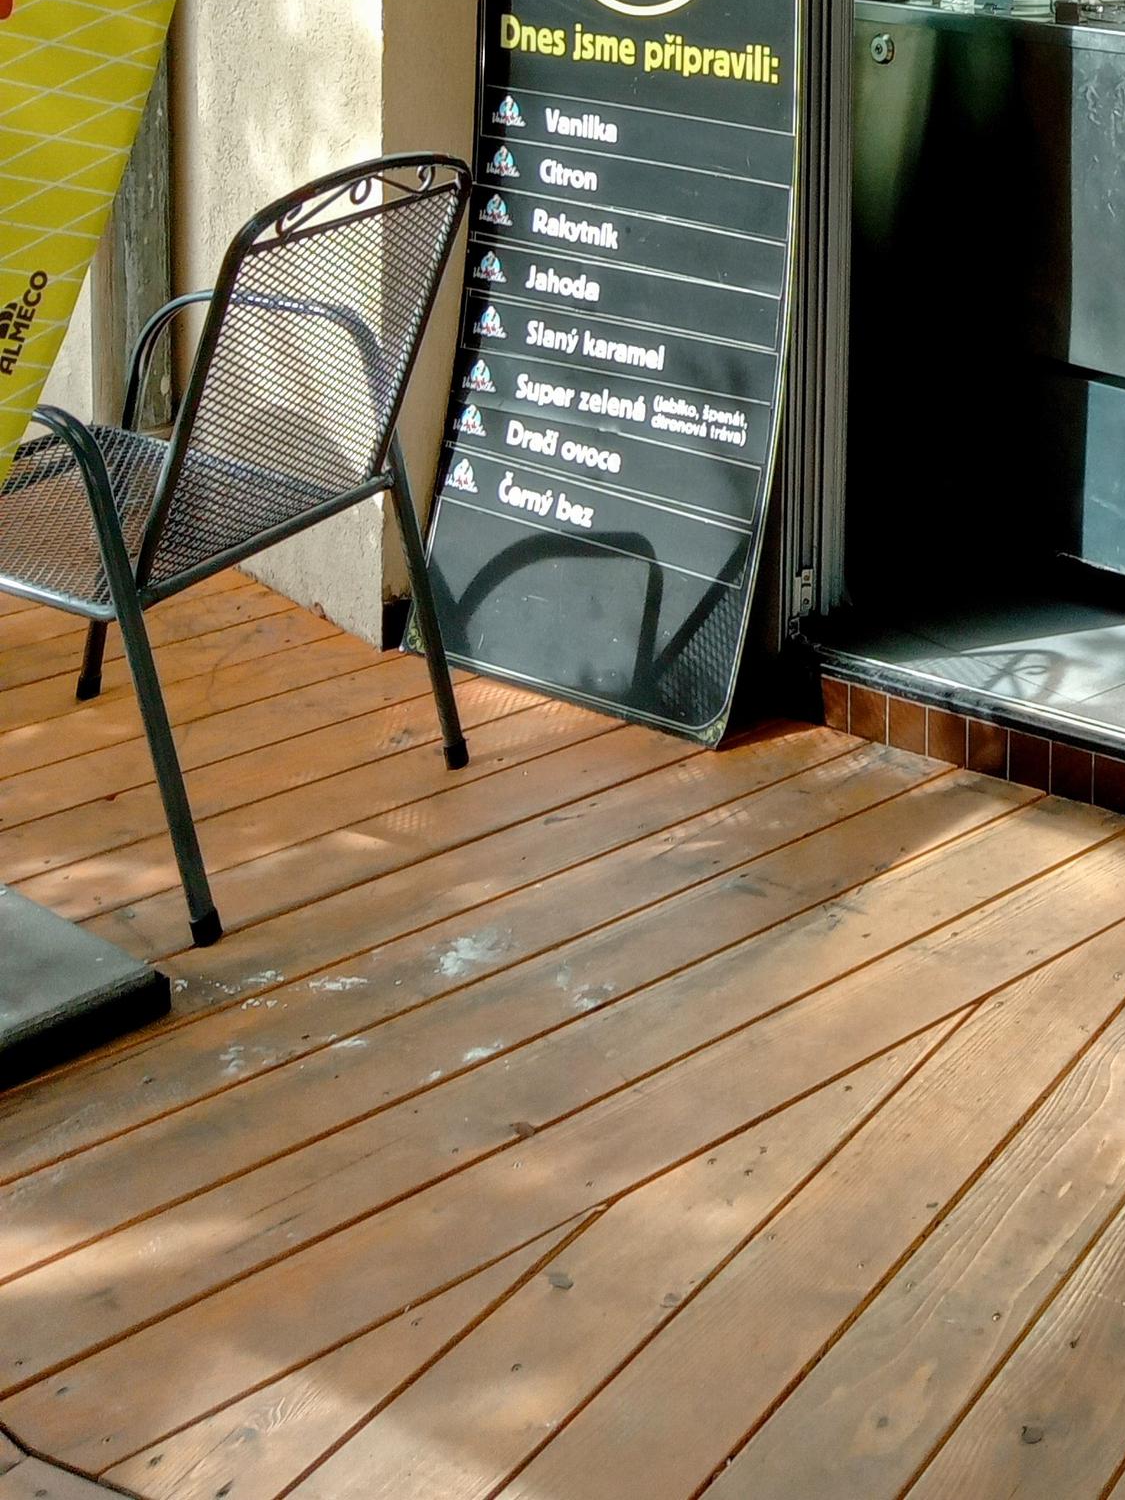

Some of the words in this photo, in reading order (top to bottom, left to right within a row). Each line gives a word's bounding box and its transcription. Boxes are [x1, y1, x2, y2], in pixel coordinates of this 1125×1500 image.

[500, 13, 566, 56] Dnes
[572, 23, 636, 66] jsme
[643, 33, 780, 84] připravili:
[544, 107, 618, 143] Vanilka
[539, 158, 598, 191] Citron
[532, 208, 619, 250] Rakytník
[525, 265, 600, 302] Jahoda
[0, 270, 48, 376] ALMECO
[526, 320, 579, 354] Slaný
[583, 328, 666, 371] karamel
[516, 373, 575, 409] Super
[579, 388, 646, 422] zelená
[506, 420, 560, 456] Dračí
[561, 441, 622, 473] ovoce
[498, 471, 553, 517] Černý
[556, 492, 595, 528] bez
